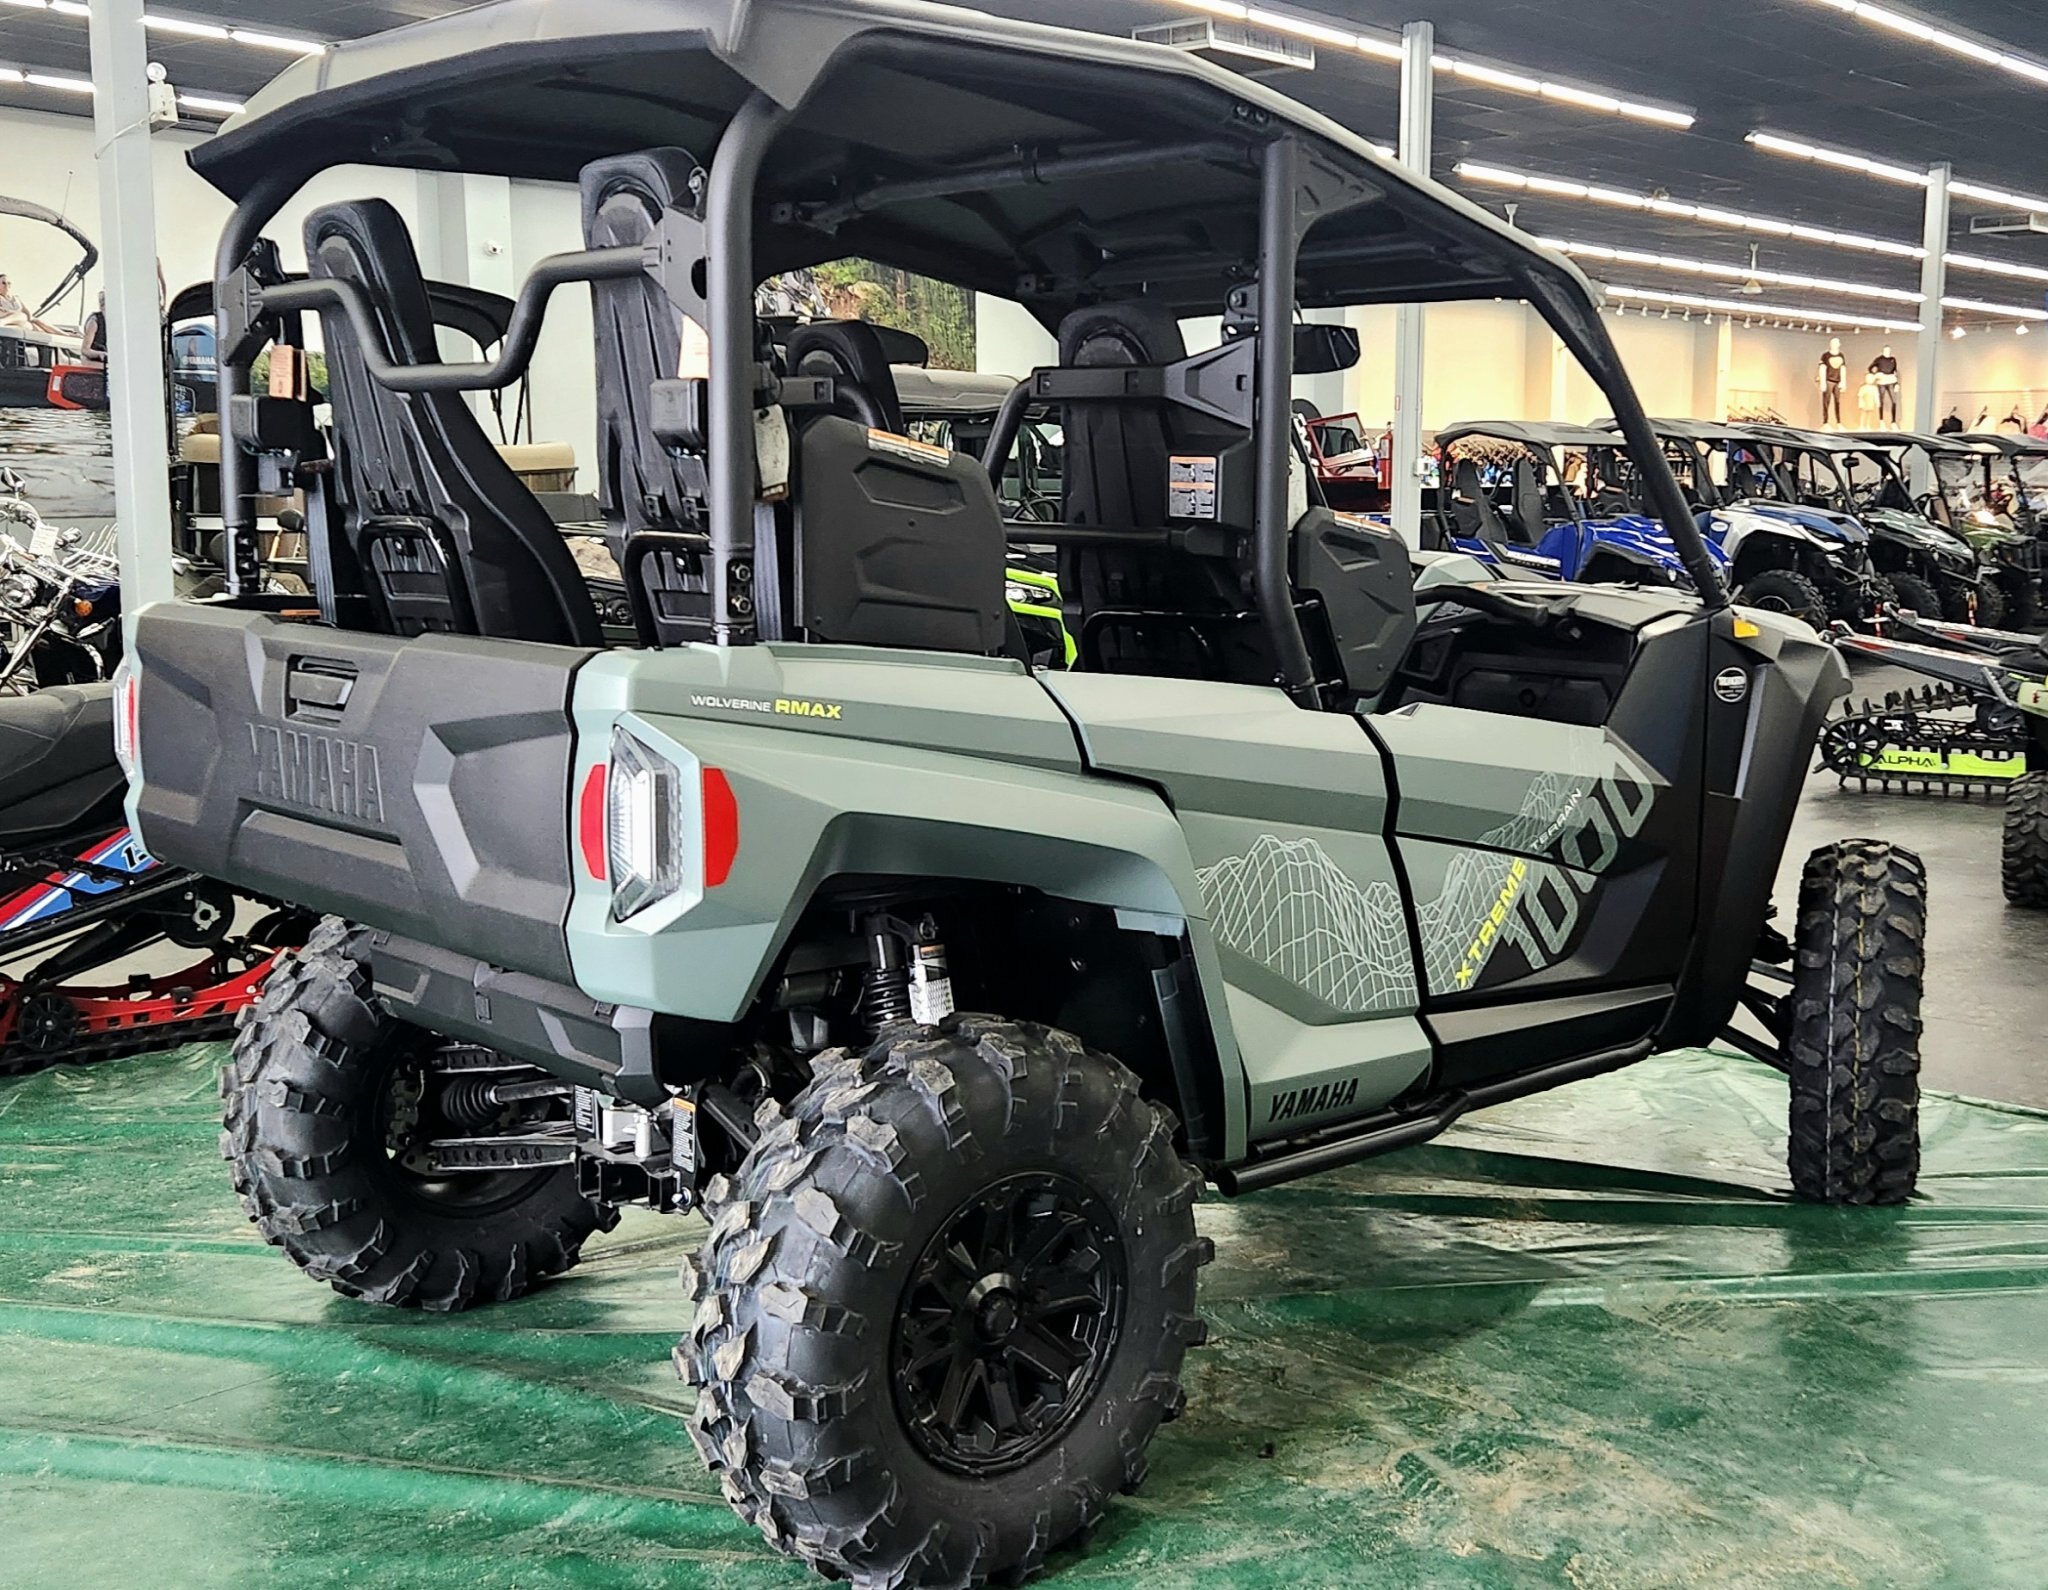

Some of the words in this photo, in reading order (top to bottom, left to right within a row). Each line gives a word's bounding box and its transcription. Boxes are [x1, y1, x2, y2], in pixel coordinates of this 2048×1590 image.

[691, 695, 771, 712] WOLVERINE
[775, 699, 842, 719] RMAX
[245, 722, 384, 823] YAMAHA
[1874, 754, 1934, 768] ALPHA
[1455, 856, 1527, 990] XTREME
[1530, 787, 1582, 850] TERRAIN
[1501, 742, 1655, 971] 1000
[1268, 1078, 1359, 1122] YAMAHA
